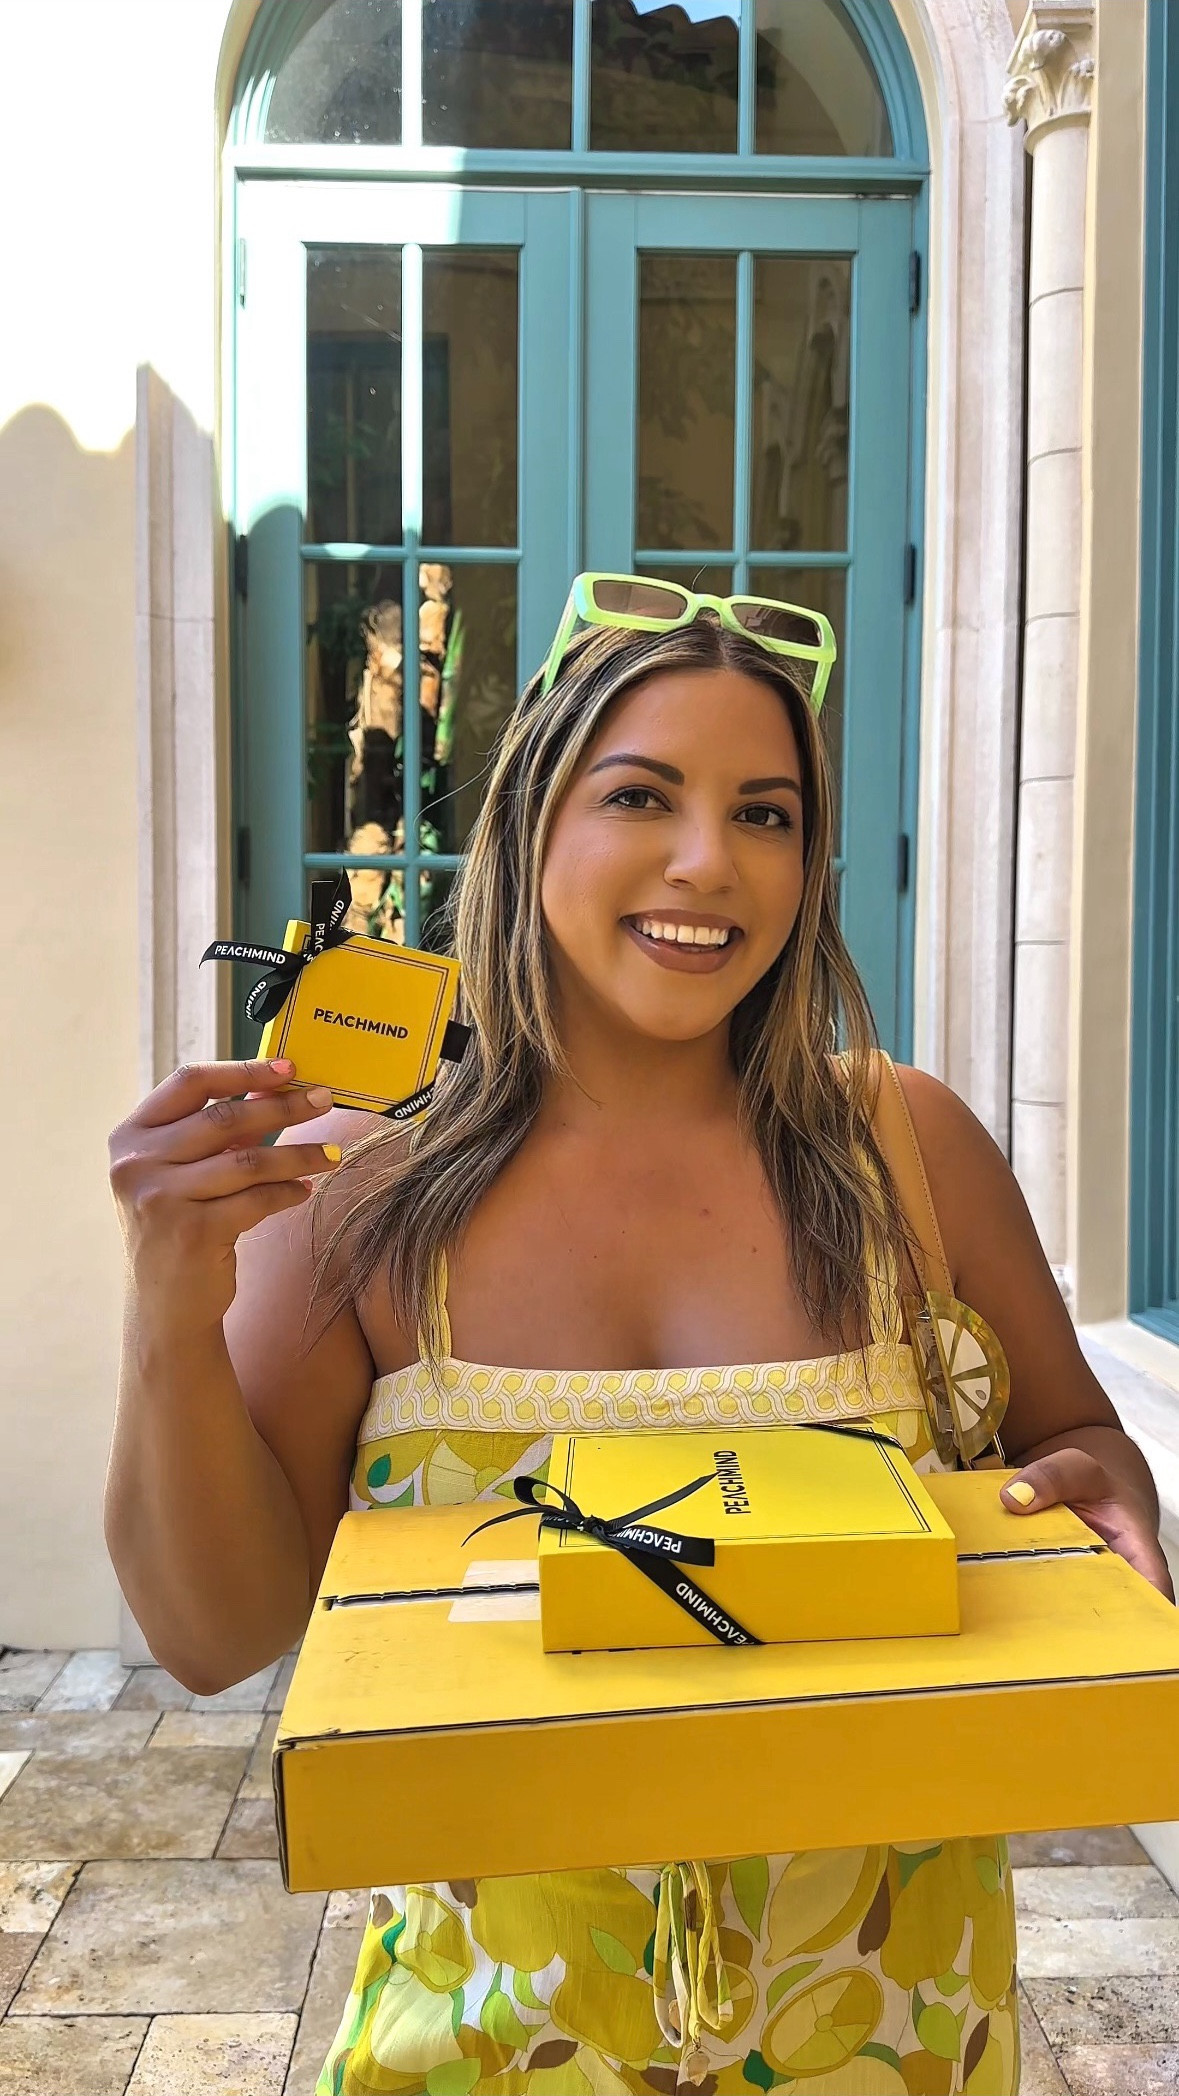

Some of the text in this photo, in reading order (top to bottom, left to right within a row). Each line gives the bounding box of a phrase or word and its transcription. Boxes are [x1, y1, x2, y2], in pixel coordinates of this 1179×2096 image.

[314, 923, 326, 952] PEAC
[214, 945, 286, 965] PEACHMIND
[313, 1007, 409, 1040] PEACHMIND
[713, 1450, 751, 1514] PEACHMIND
[675, 1582, 755, 1645] EACHMIND
